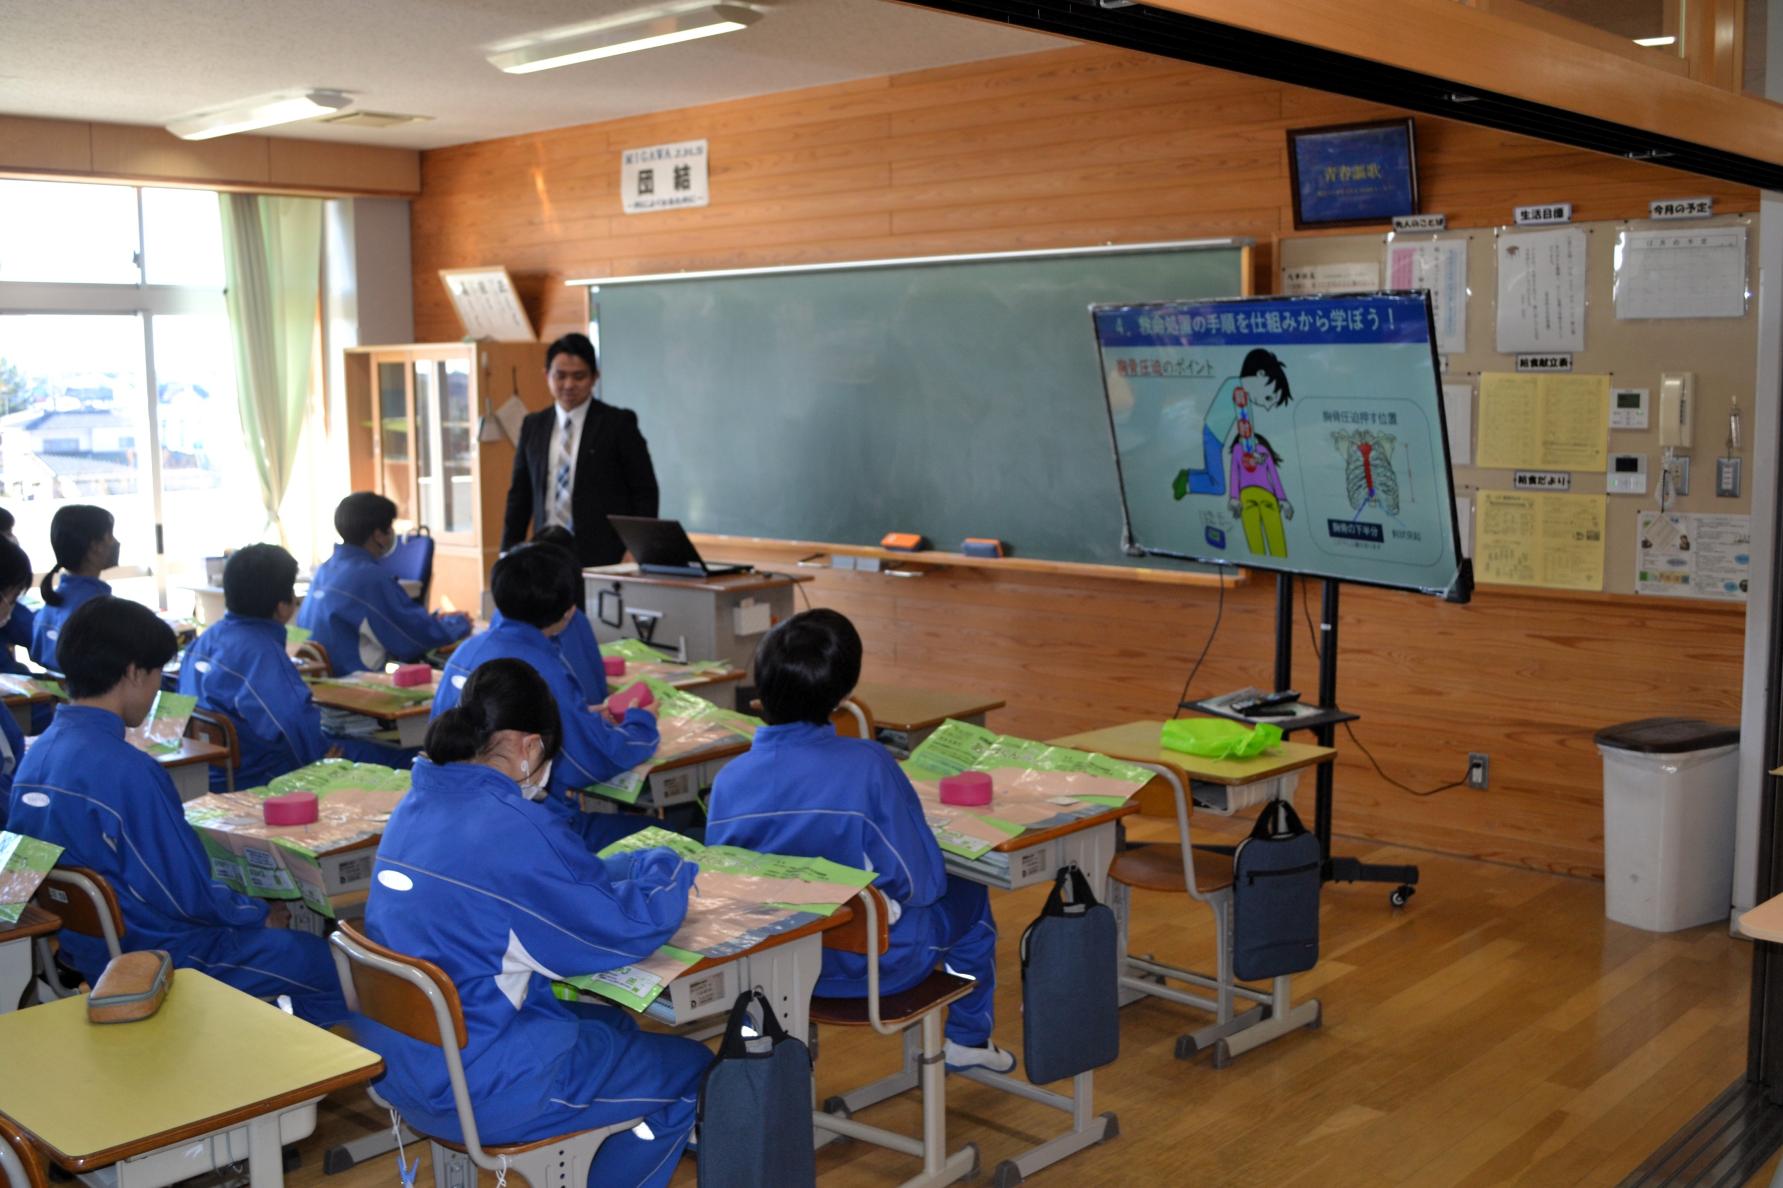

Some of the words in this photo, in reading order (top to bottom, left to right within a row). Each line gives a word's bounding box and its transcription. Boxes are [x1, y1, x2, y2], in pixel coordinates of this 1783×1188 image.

[639, 164, 691, 194] 団結
[1520, 207, 1564, 220] 生活目標
[1654, 202, 1708, 215] 今月の予定
[1520, 357, 1568, 368] 給食献立表
[1518, 475, 1566, 486] 給食だより
